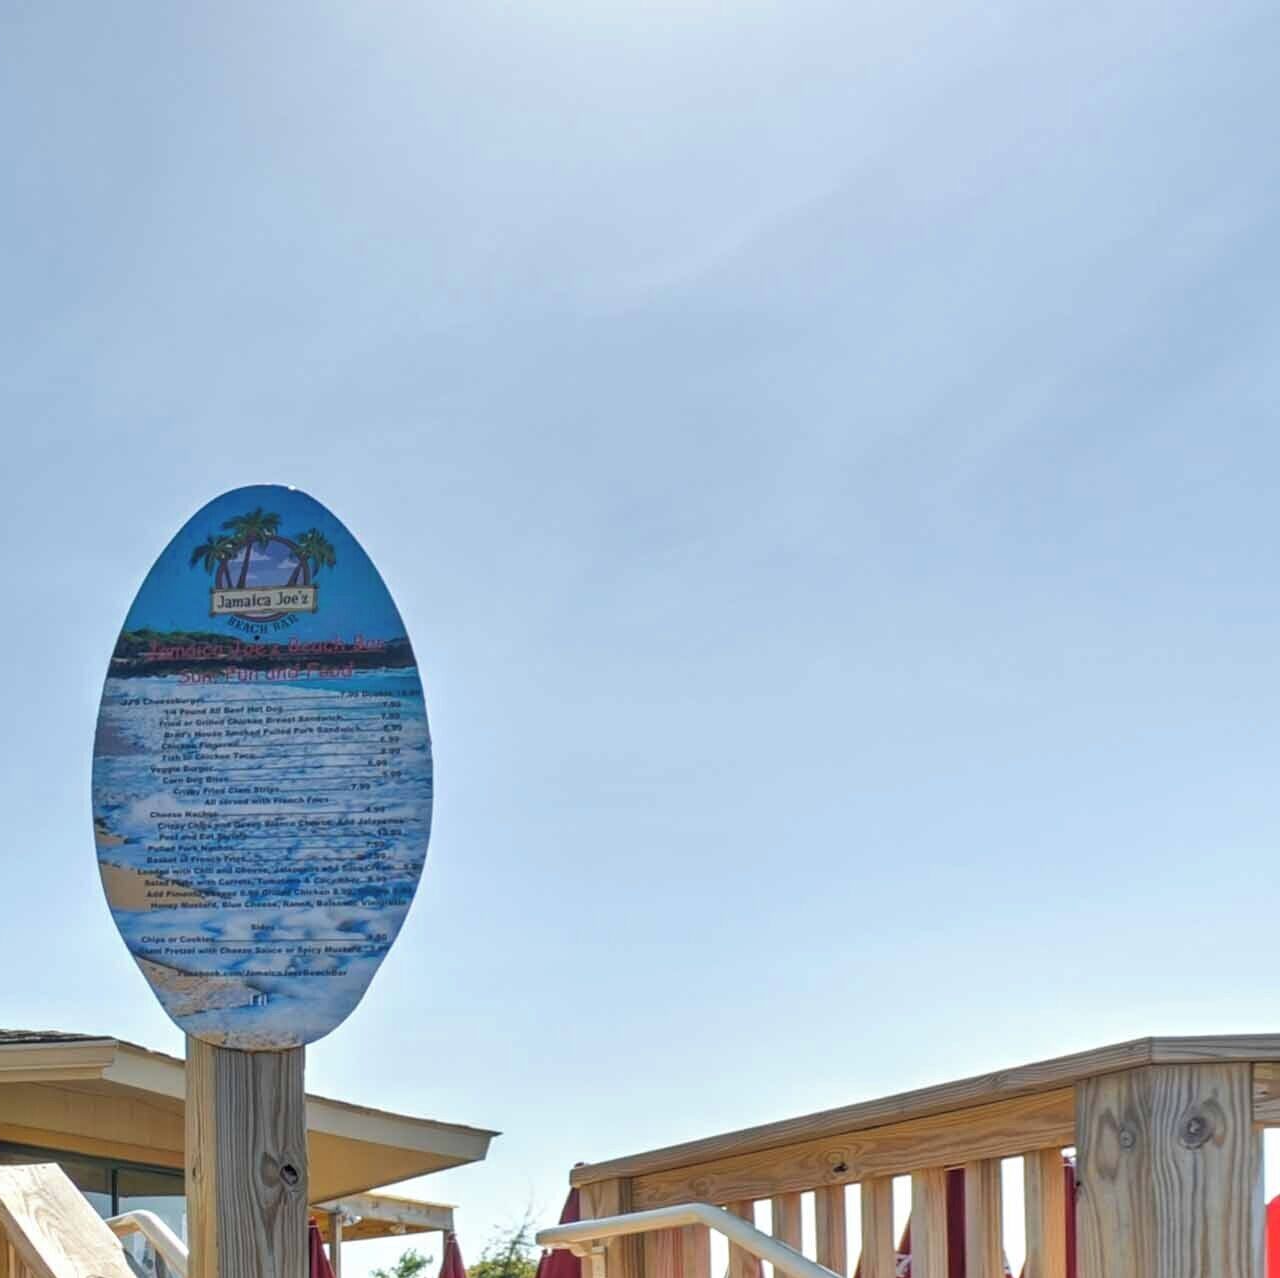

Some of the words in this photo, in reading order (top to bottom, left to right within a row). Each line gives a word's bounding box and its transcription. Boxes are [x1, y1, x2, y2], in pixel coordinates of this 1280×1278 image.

[217, 594, 271, 610] Jamaica
[276, 590, 308, 606] Joe'z
[226, 616, 268, 634] BEACH
[273, 614, 299, 632] BAR
[226, 667, 258, 682] Fun
[266, 664, 301, 681] and
[307, 662, 353, 679] Food
[298, 715, 343, 723] Sandwich
[225, 729, 261, 737] Smoked
[263, 727, 291, 736] Pulled
[294, 726, 314, 734] Pork
[317, 725, 360, 733] Sandwich
[186, 777, 203, 785] Dog
[203, 787, 225, 795] Fried
[273, 796, 304, 804] French
[141, 935, 166, 944] Chips
[198, 946, 217, 954] with
